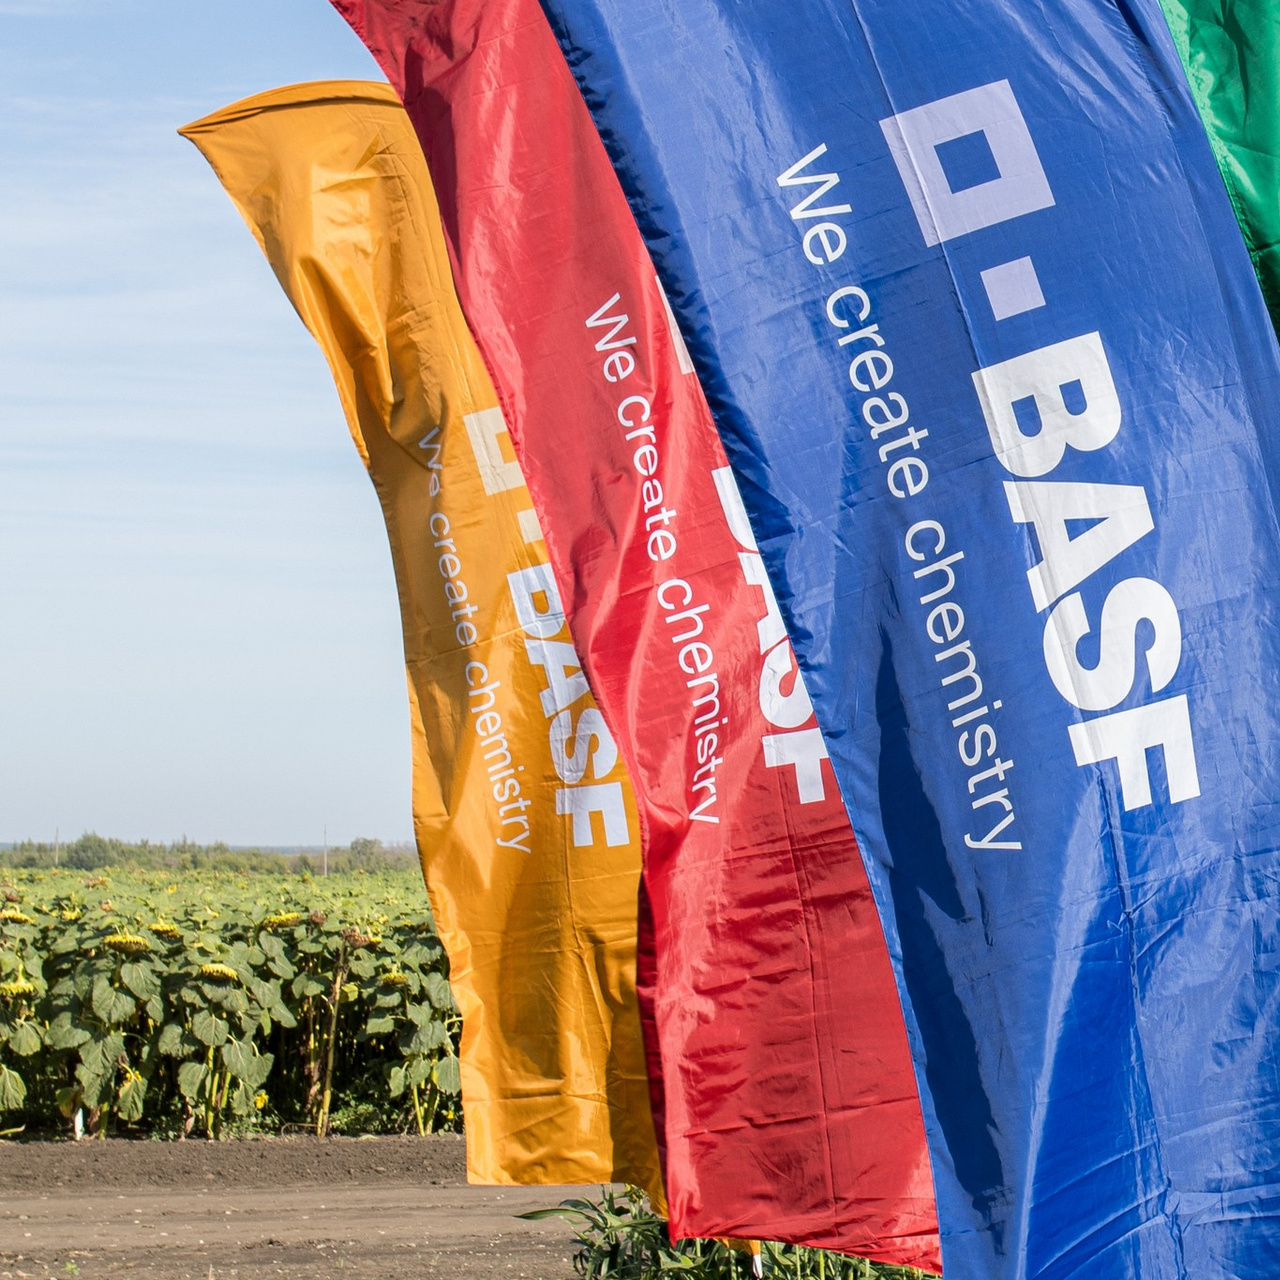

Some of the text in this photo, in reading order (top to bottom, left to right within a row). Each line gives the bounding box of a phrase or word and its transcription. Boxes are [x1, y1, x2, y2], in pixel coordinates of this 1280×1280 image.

[585, 292, 637, 383] We
[618, 395, 677, 561] create
[776, 143, 1021, 851] We create chemistry
[971, 331, 1200, 812] BASF
[430, 513, 478, 646] create
[465, 661, 531, 853] chemistry
